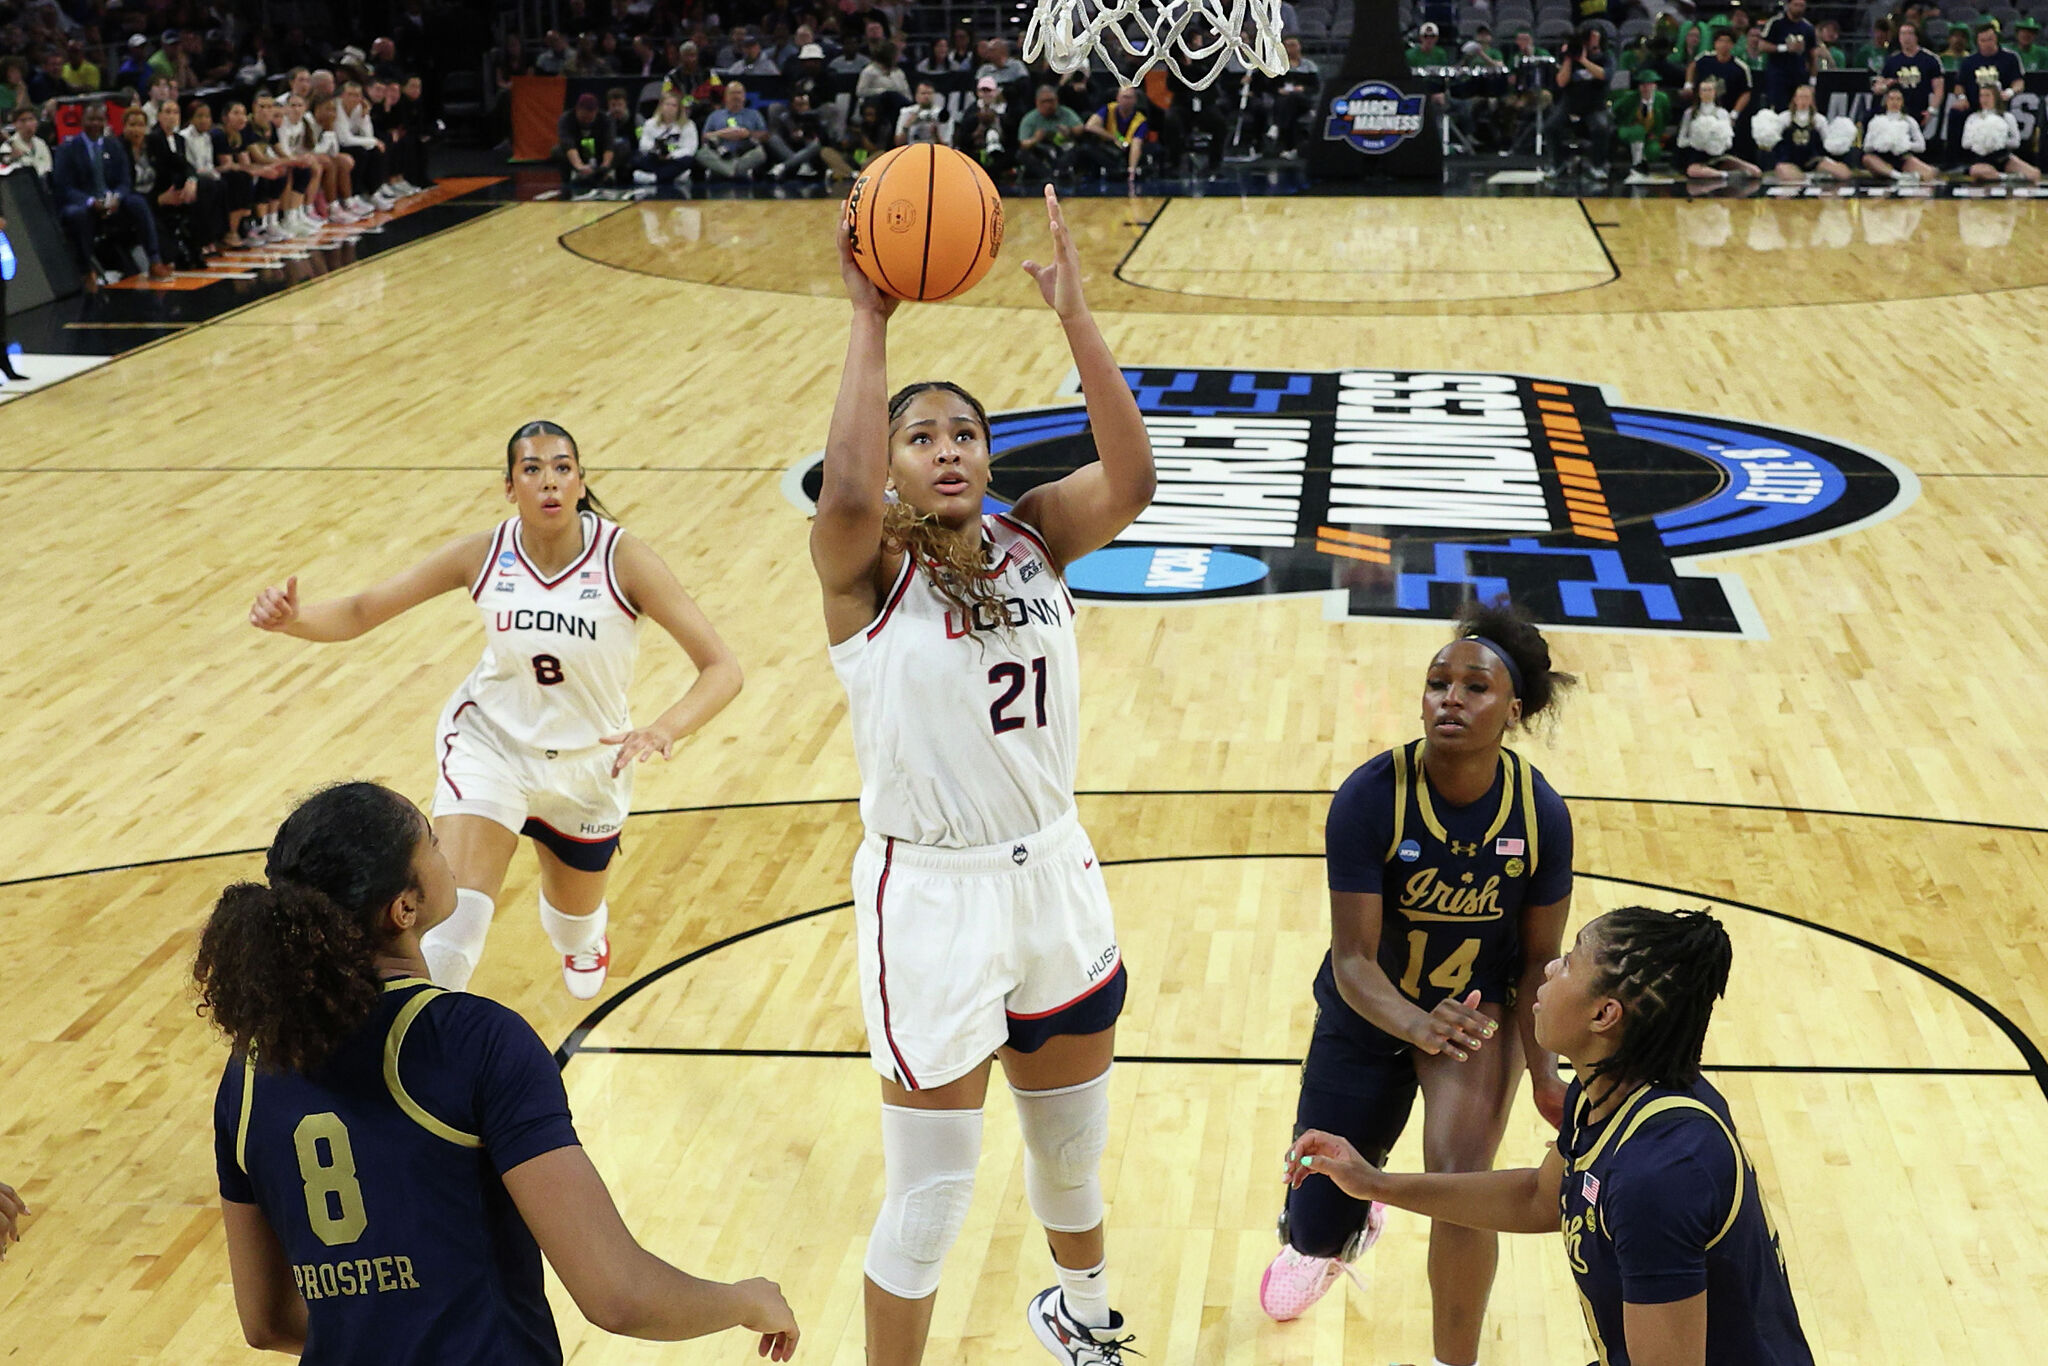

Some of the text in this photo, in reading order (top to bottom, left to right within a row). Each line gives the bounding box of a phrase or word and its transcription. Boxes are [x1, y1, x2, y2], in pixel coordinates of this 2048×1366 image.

[1326, 373, 1552, 531] MADNESS
[496, 609, 596, 640] UCONN
[944, 598, 1061, 639] UCONN
[532, 654, 564, 685] 8
[988, 656, 1047, 735] 21
[1398, 868, 1503, 921] Irish
[1400, 928, 1481, 1000] 14
[294, 1112, 368, 1247] 8
[292, 1255, 421, 1300] PROSPER
